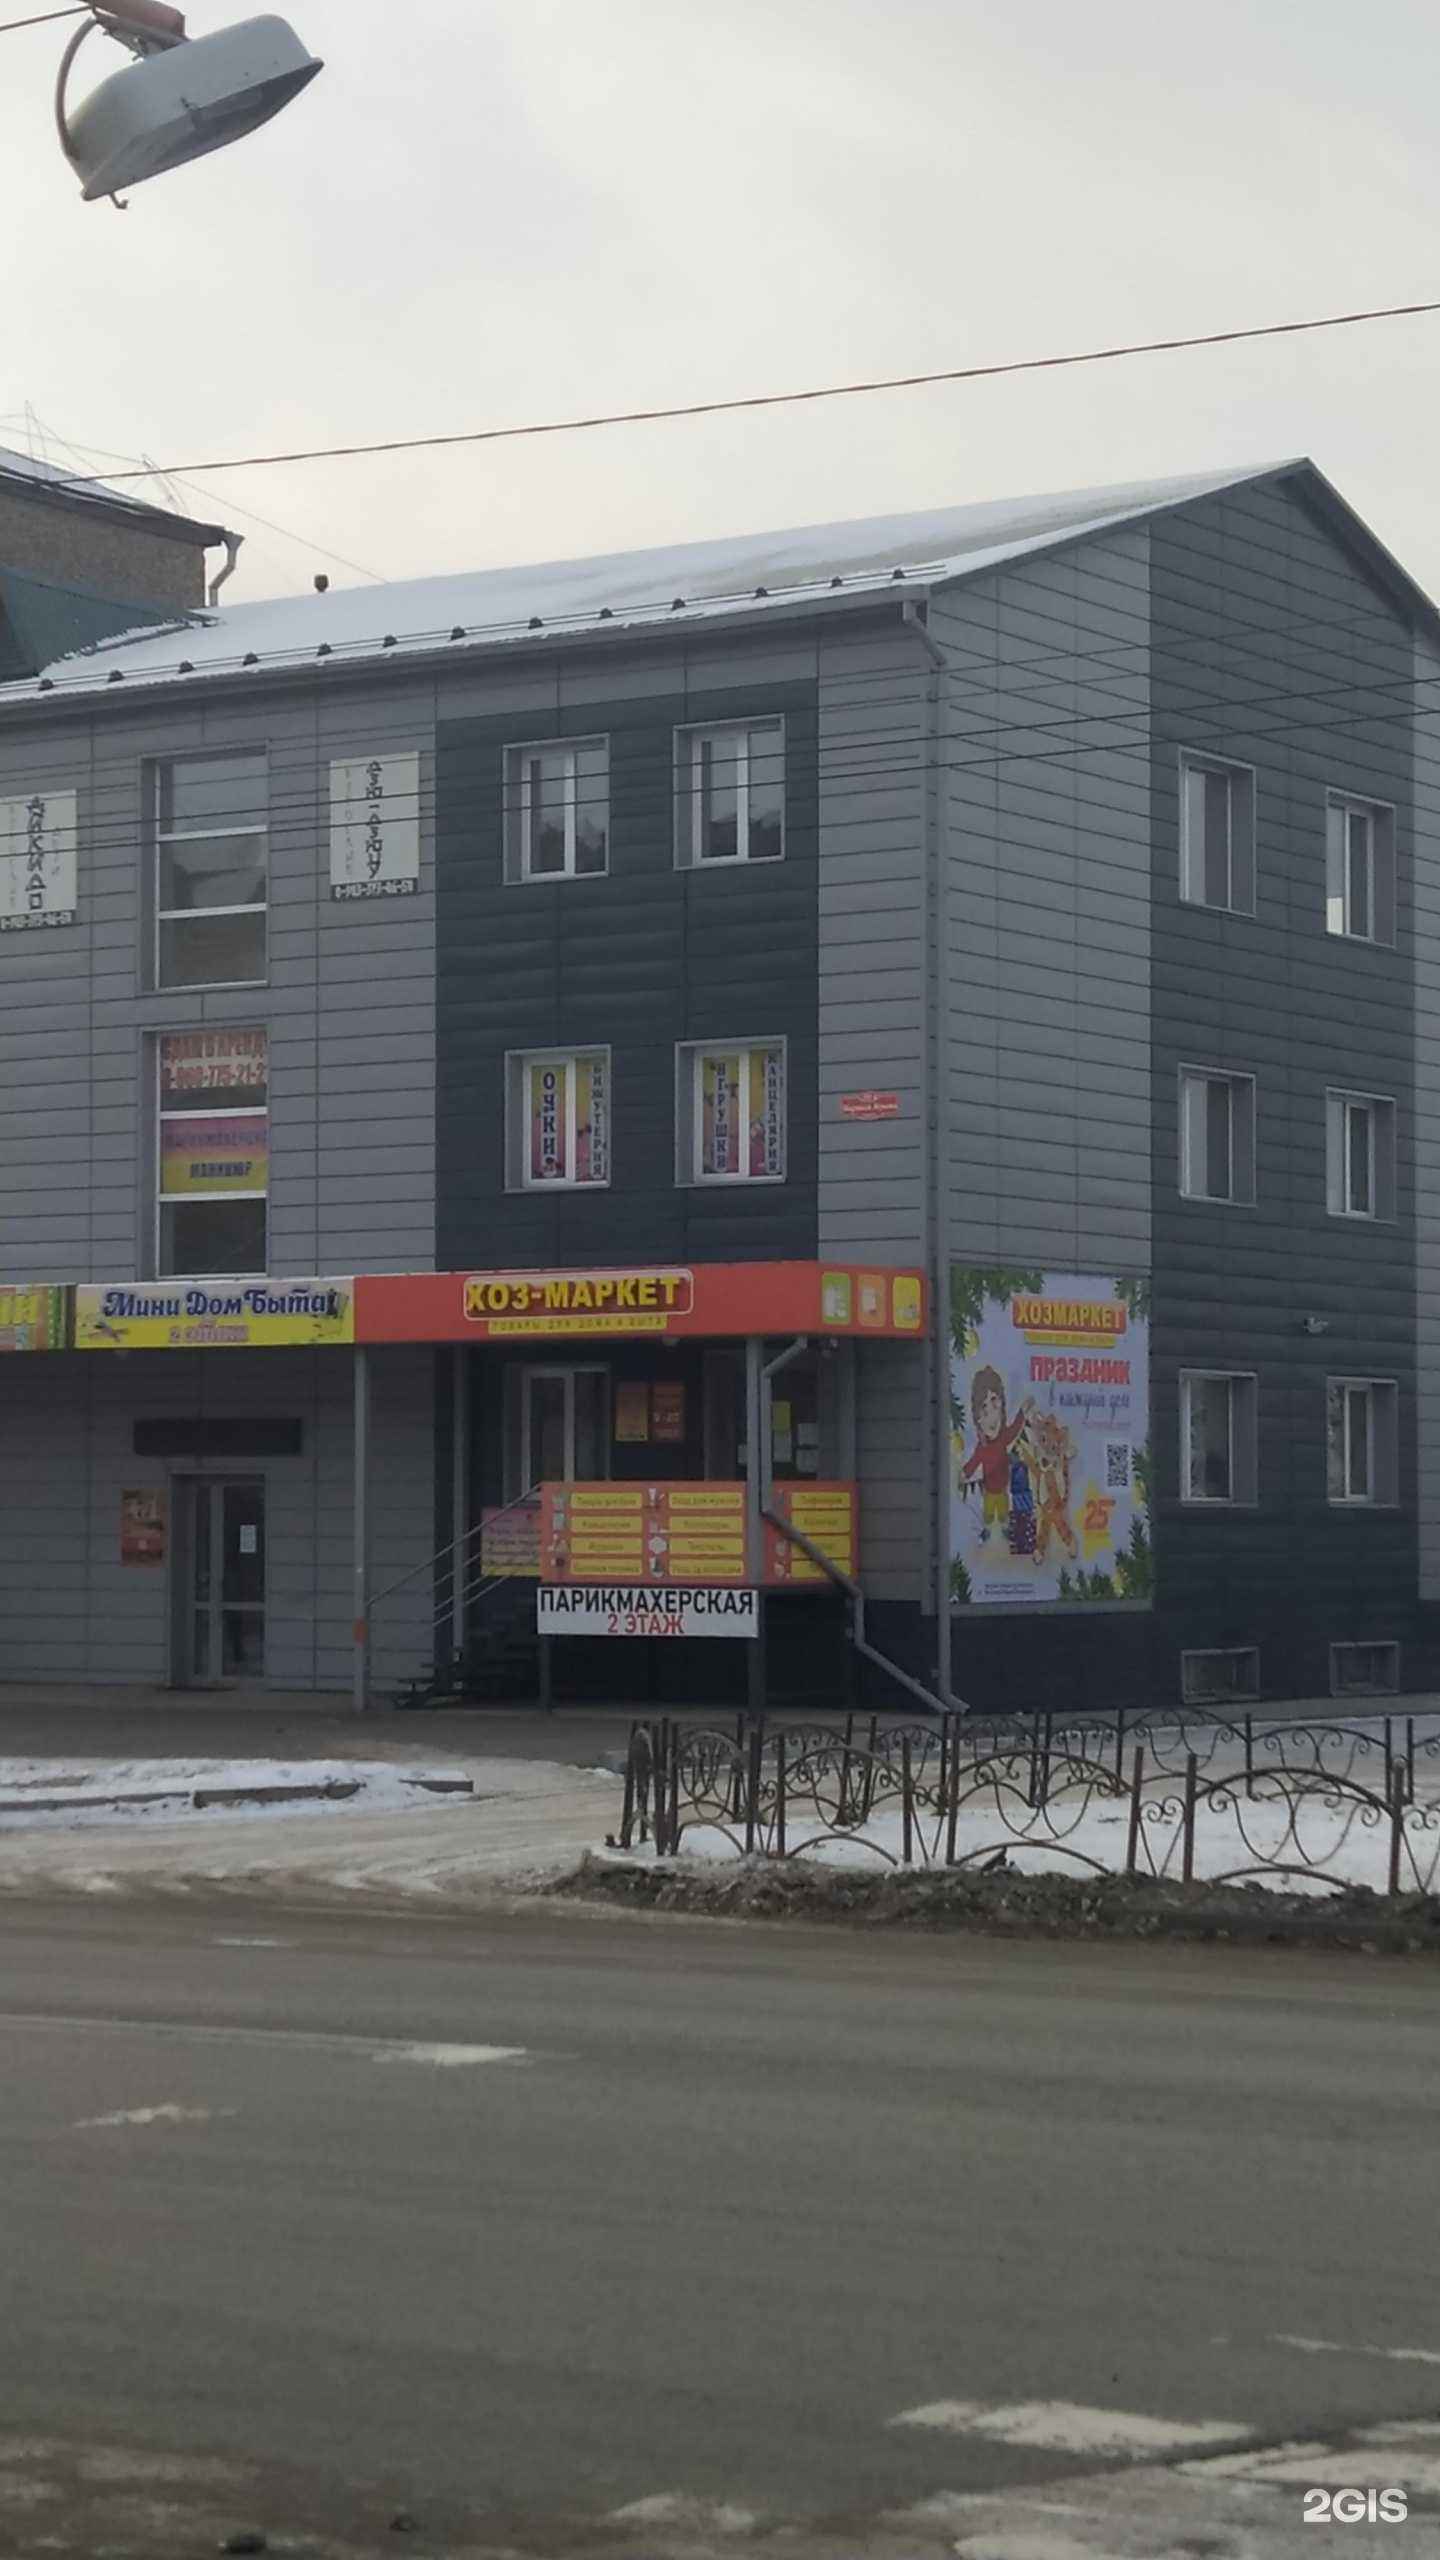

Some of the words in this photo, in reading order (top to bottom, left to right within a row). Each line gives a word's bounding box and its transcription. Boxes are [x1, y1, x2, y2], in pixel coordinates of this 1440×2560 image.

[543, 1071, 556, 1155] ОЧКИ
[103, 1289, 179, 1317] Мини
[186, 1290, 243, 1316] Дом
[244, 1286, 327, 1314] Быта
[466, 1274, 680, 1312] ХОЗ-МАРКЕТ
[1017, 1300, 1121, 1329] ХОЗМАРКЕТ
[540, 1589, 753, 1616] ПАРИКМАХЕРСКАЯ
[607, 1614, 618, 1633] 2
[625, 1613, 685, 1634] ЭТАЖ
